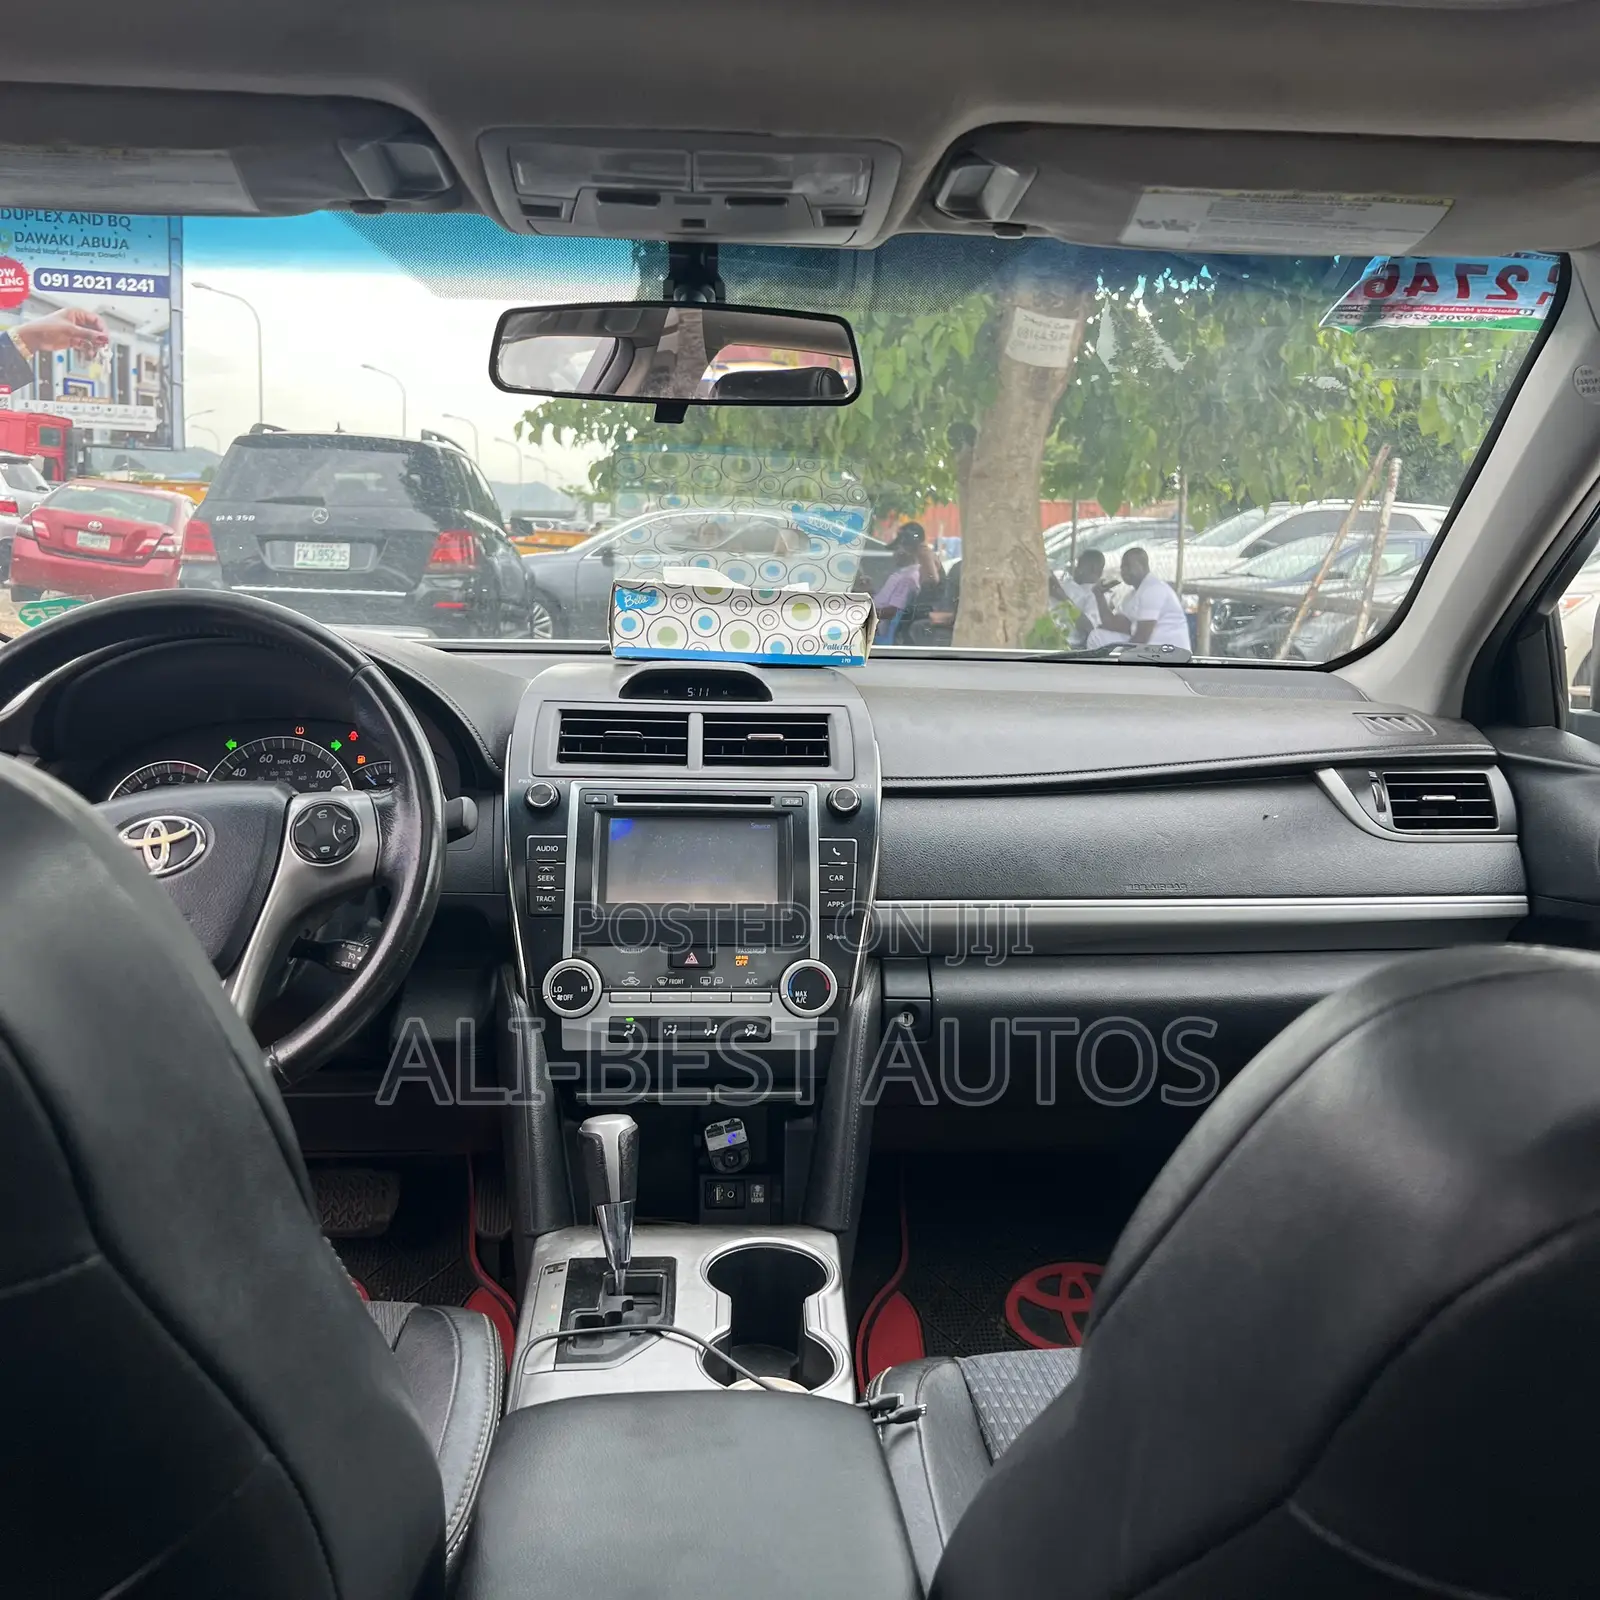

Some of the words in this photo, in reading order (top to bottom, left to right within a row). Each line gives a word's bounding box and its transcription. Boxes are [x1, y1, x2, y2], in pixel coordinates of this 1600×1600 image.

[0, 207, 64, 223] DUPLEX
[68, 212, 103, 226] AND
[108, 214, 131, 232] BQ
[14, 231, 74, 246] DAWAKI
[40, 272, 69, 288] 091
[73, 275, 112, 291] 2021
[116, 277, 155, 293] 4241
[235, 514, 256, 522] 350
[687, 687, 710, 697] 5:11
[259, 754, 273, 764] 60
[292, 754, 306, 764] 80
[231, 768, 247, 777] 40
[316, 769, 332, 779] 100
[750, 822, 771, 830] Source
[537, 874, 556, 882] SEEK
[828, 874, 844, 882] CAR
[535, 895, 556, 903] TRACK
[826, 900, 846, 908] APPS
[735, 959, 748, 967] OFF
[668, 977, 685, 985] FRONT
[744, 977, 758, 985] A/C
[553, 985, 563, 993] LO
[580, 985, 588, 993] HI
[563, 993, 574, 1001] OFF
